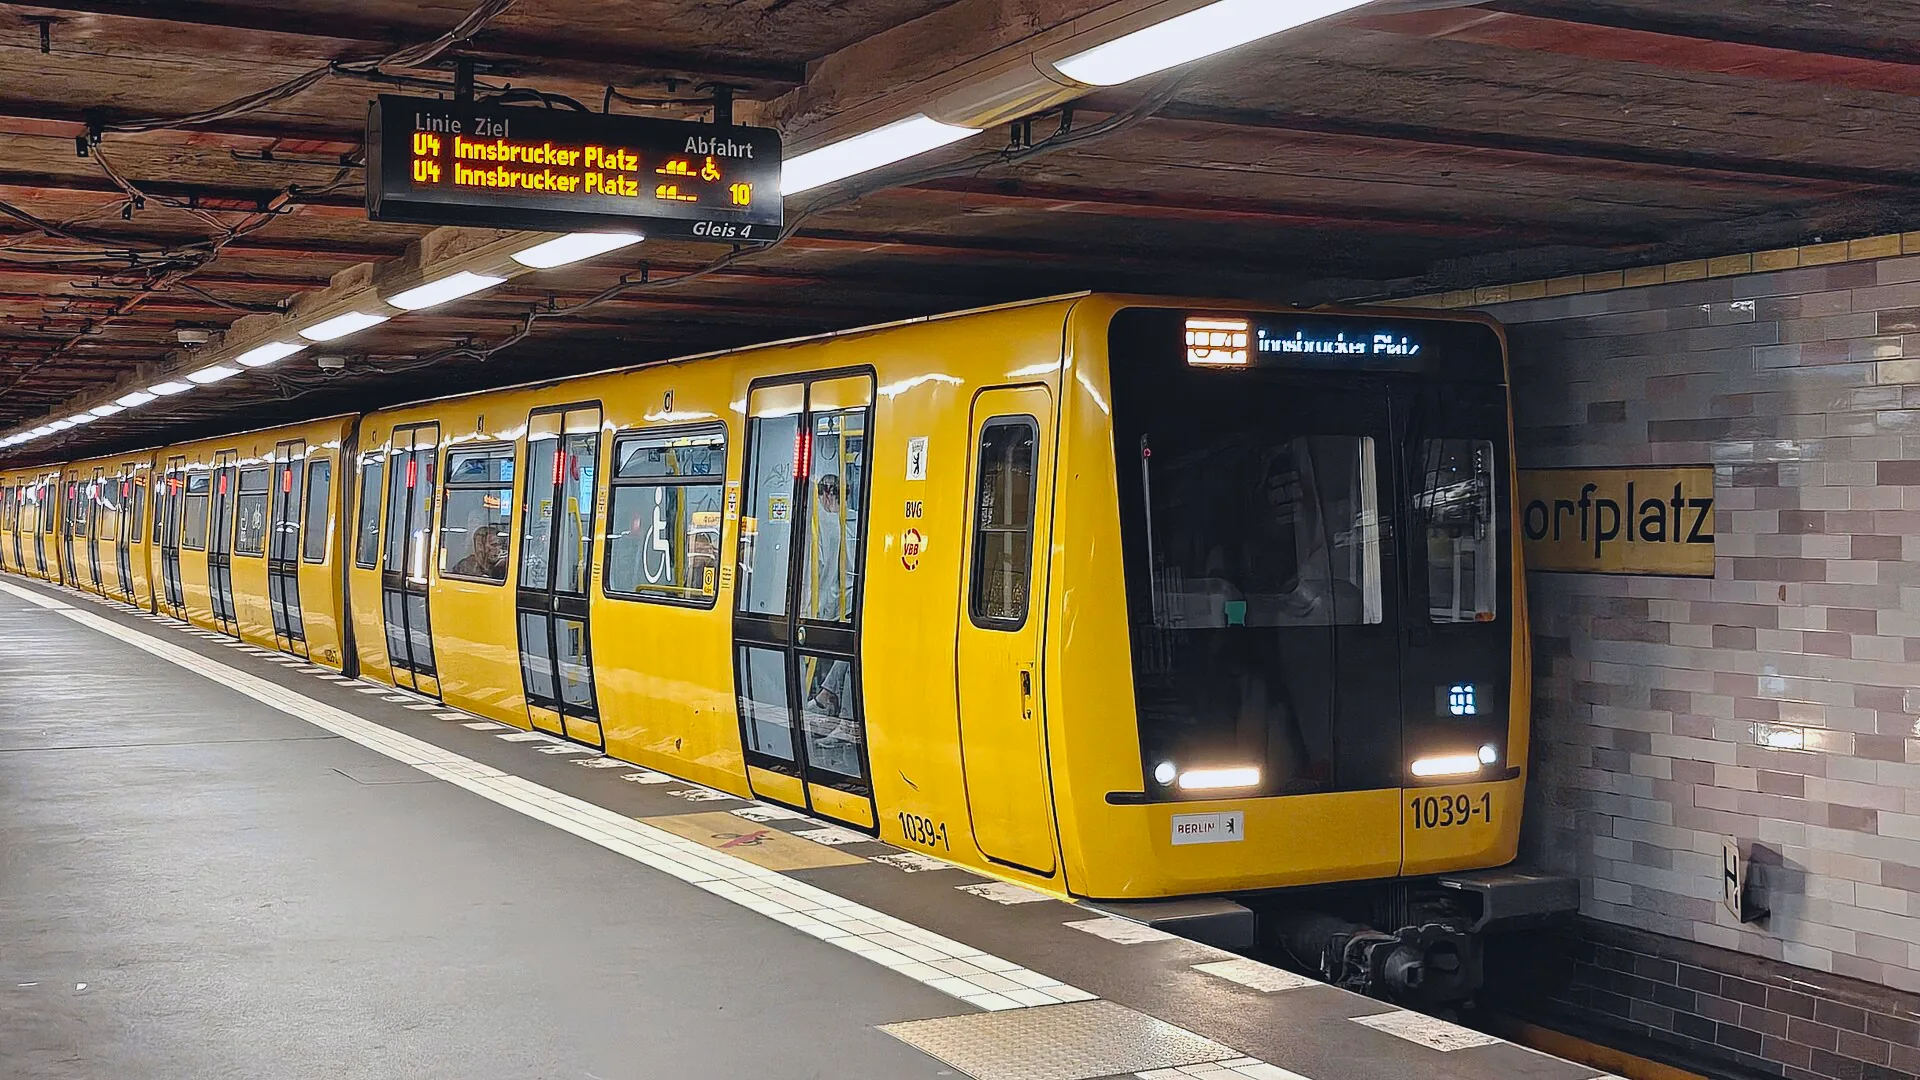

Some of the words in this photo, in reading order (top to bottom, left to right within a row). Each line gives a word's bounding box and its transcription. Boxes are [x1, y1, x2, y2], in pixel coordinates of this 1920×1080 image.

[415, 112, 461, 134] Linie
[474, 117, 510, 138] Ziel
[413, 133, 441, 158] U4
[454, 136, 580, 168] Innsbrucker
[584, 146, 639, 173] Platz
[684, 136, 754, 160] Abfahrt
[413, 159, 441, 184] U4
[454, 162, 580, 194] Innsbrucker
[584, 172, 639, 198] Platz
[692, 221, 736, 239] Gleis
[739, 222, 752, 239] 4
[905, 501, 923, 519] BVG
[1523, 480, 1715, 560] orfplatz
[903, 543, 920, 556] VBB
[1410, 792, 1492, 830] 1039-1
[898, 811, 950, 852] 1039-1
[1177, 822, 1215, 834] BERLIN
